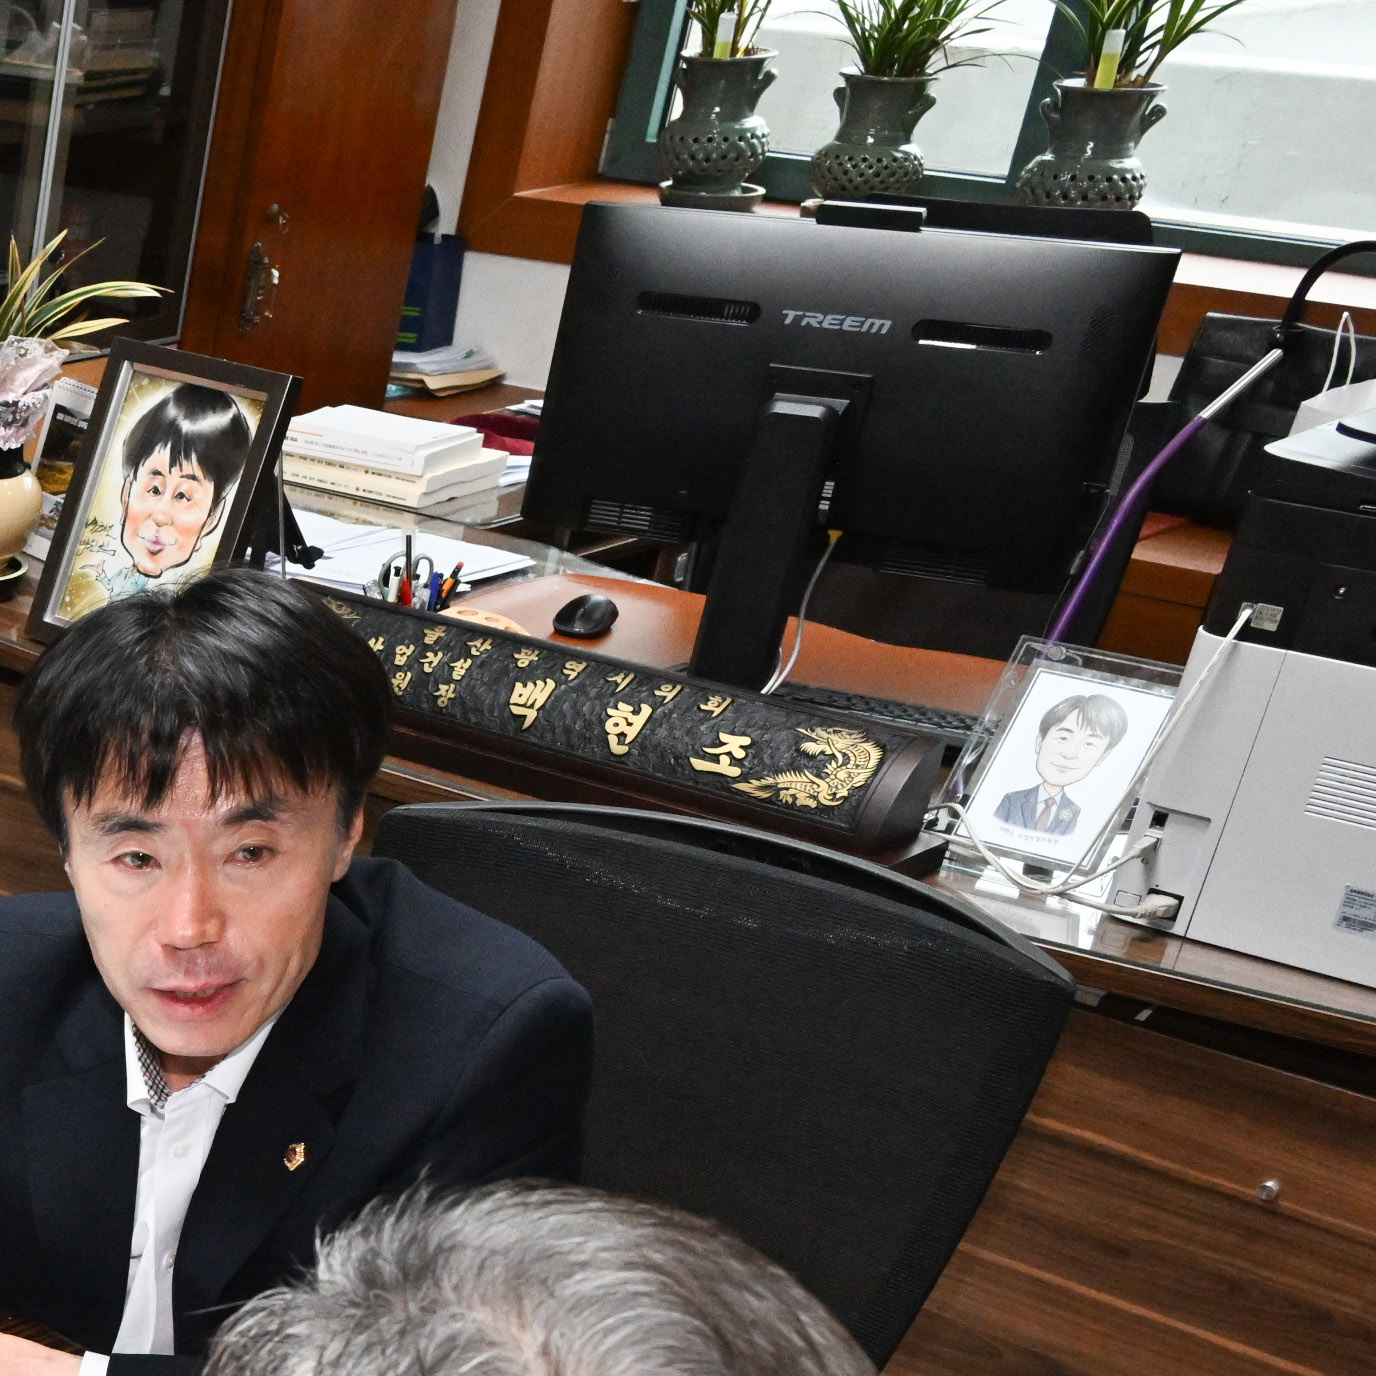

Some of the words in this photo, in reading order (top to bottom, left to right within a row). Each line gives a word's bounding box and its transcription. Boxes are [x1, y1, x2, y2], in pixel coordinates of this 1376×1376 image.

[782, 309, 893, 335] TREEM
[391, 671, 457, 709] 원장
[422, 624, 733, 718] 울산광역시의회
[508, 676, 753, 779] 백현조
